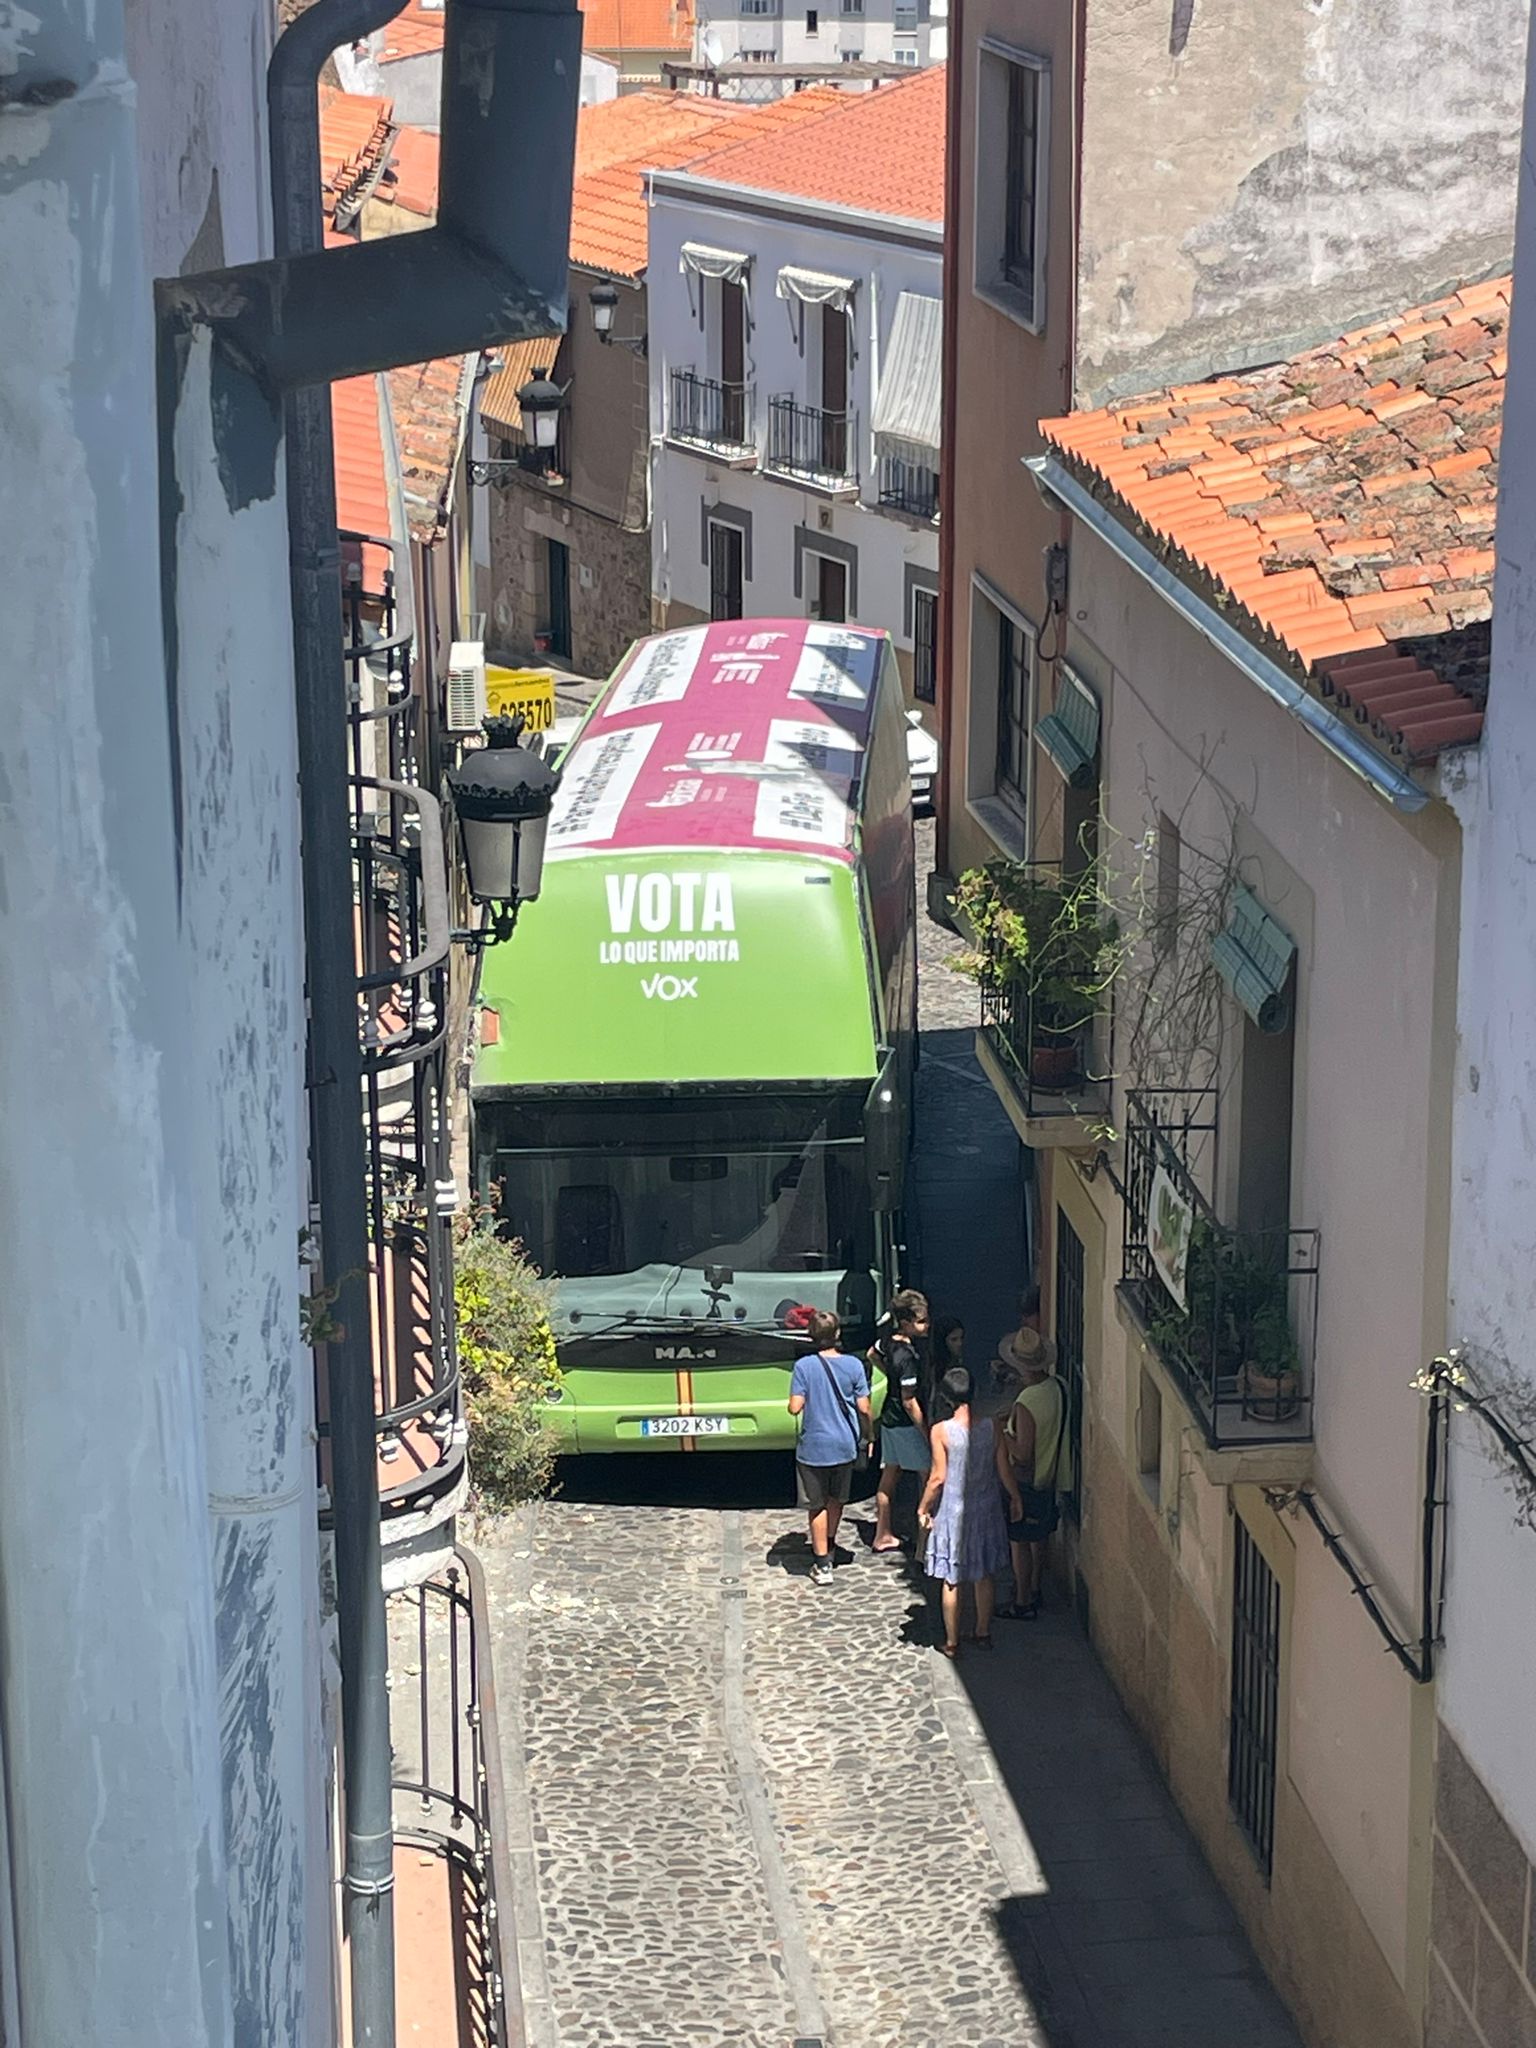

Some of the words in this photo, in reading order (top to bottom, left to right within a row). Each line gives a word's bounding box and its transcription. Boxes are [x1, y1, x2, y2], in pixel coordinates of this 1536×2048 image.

[604, 872, 735, 933] VOTA
[600, 941, 621, 964] LO
[624, 941, 658, 964] QUE
[660, 939, 740, 963] IMPORTA
[652, 1419, 690, 1434] 3202
[694, 1418, 723, 1433] KSY
